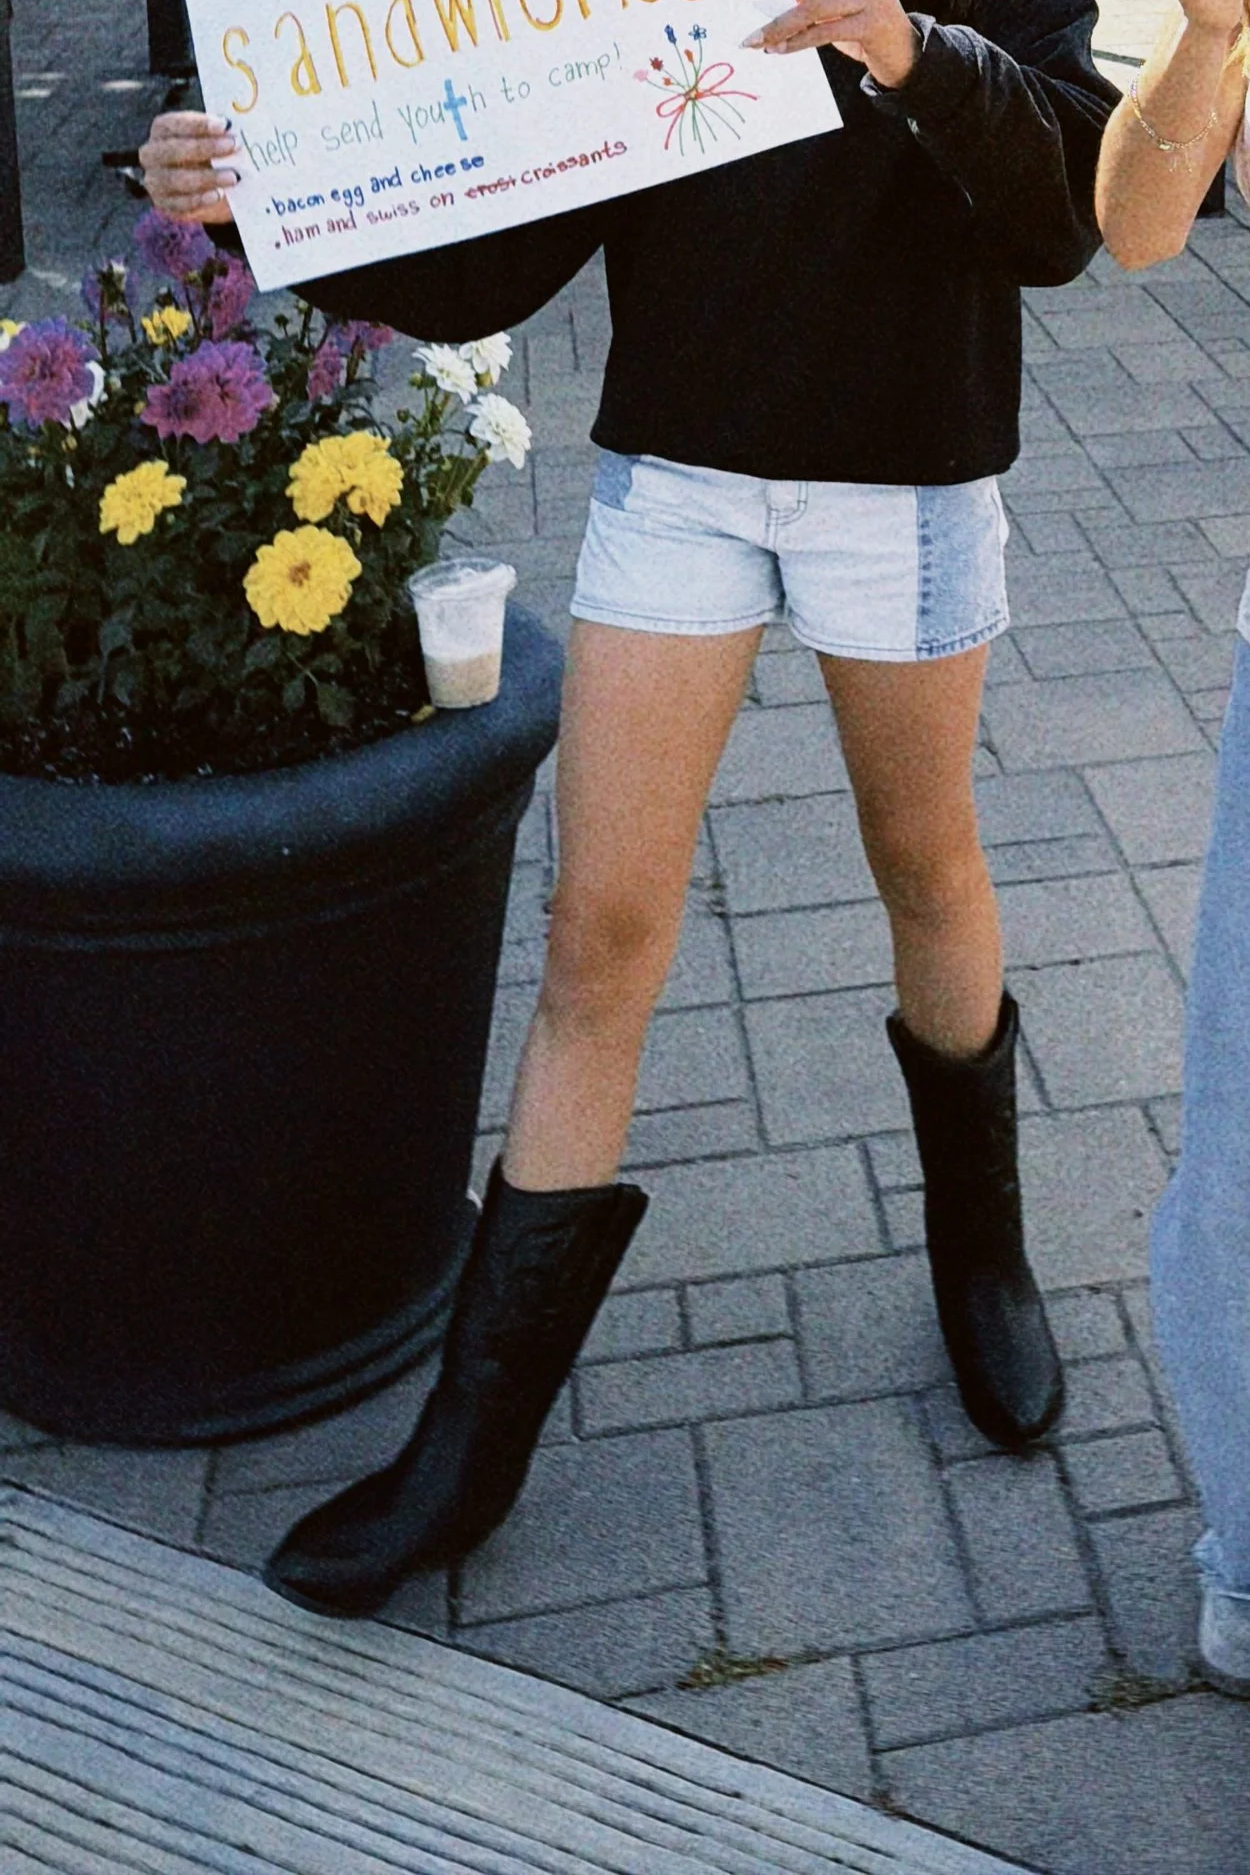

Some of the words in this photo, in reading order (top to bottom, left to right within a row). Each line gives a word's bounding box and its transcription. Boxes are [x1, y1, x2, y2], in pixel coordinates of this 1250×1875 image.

[240, 126, 299, 172] help
[321, 99, 384, 152] send
[397, 78, 487, 145] youth
[500, 76, 532, 104] to
[548, 42, 624, 87] camp!
[271, 195, 325, 216] bacon
[330, 185, 365, 207] egg
[371, 166, 403, 194] and
[410, 155, 485, 184] cheese
[281, 225, 321, 247] ham
[326, 209, 358, 234] and
[366, 199, 421, 225] swiss
[429, 191, 456, 209] on
[520, 140, 628, 185] croissants
